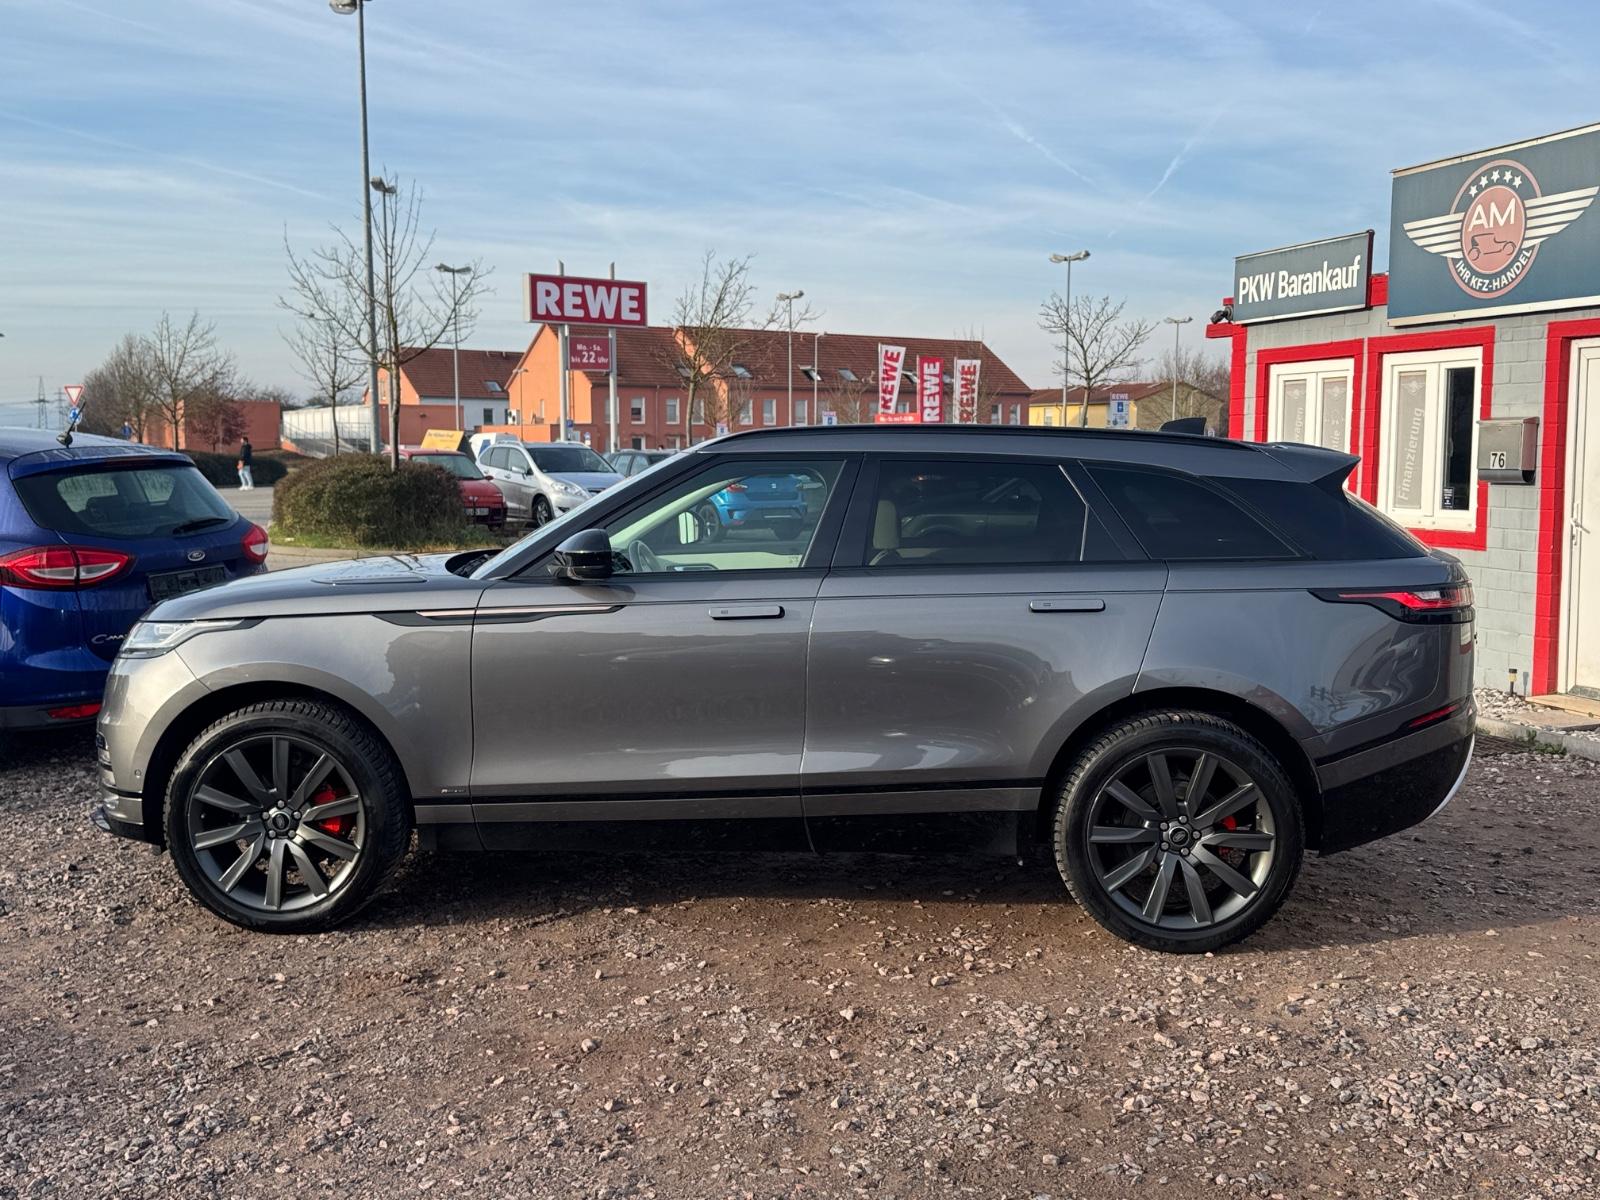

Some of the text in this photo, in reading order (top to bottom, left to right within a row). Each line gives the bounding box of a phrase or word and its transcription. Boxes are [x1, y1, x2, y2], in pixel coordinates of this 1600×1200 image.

[1468, 198, 1516, 231] AM
[1238, 255, 1361, 305] PKW Barankauf
[1455, 247, 1532, 291] IHR KFZ-HANDEL
[536, 281, 641, 321] REWE
[582, 351, 596, 363] 22
[881, 350, 901, 410] REWE
[923, 362, 940, 422] REWE
[1398, 407, 1425, 500] Finanzierung
[1491, 453, 1505, 468] 76
